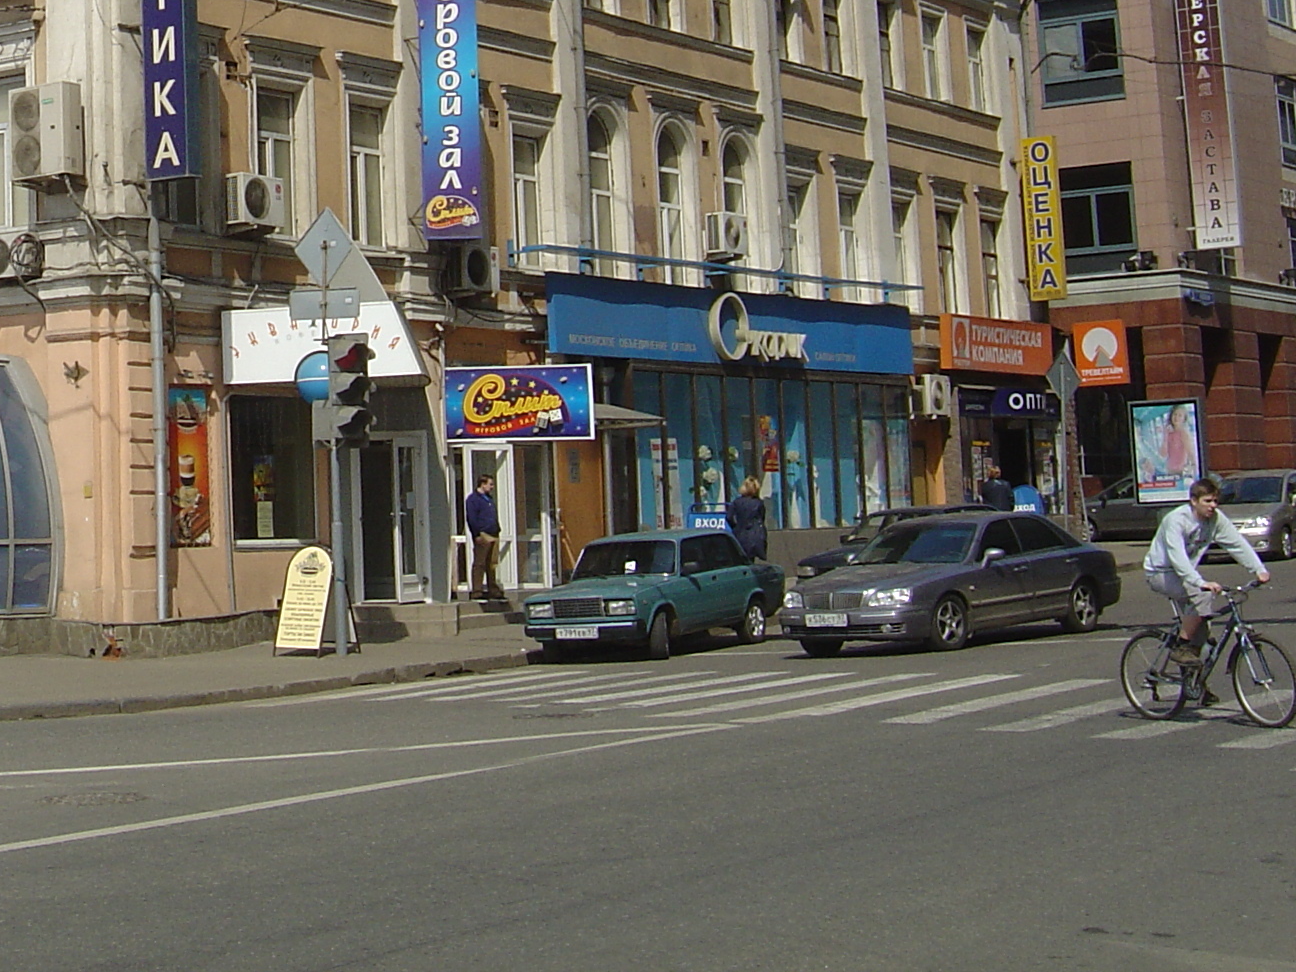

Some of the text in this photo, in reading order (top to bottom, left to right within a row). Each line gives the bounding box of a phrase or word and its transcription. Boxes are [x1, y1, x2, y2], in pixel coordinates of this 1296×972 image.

[1030, 142, 1058, 289] ОЦЕНКА
[971, 324, 1042, 348] ТУРИСТИЧЕСКАЯ
[971, 345, 1024, 366] КОМПАНИЯ
[695, 518, 726, 529] ВХОД
